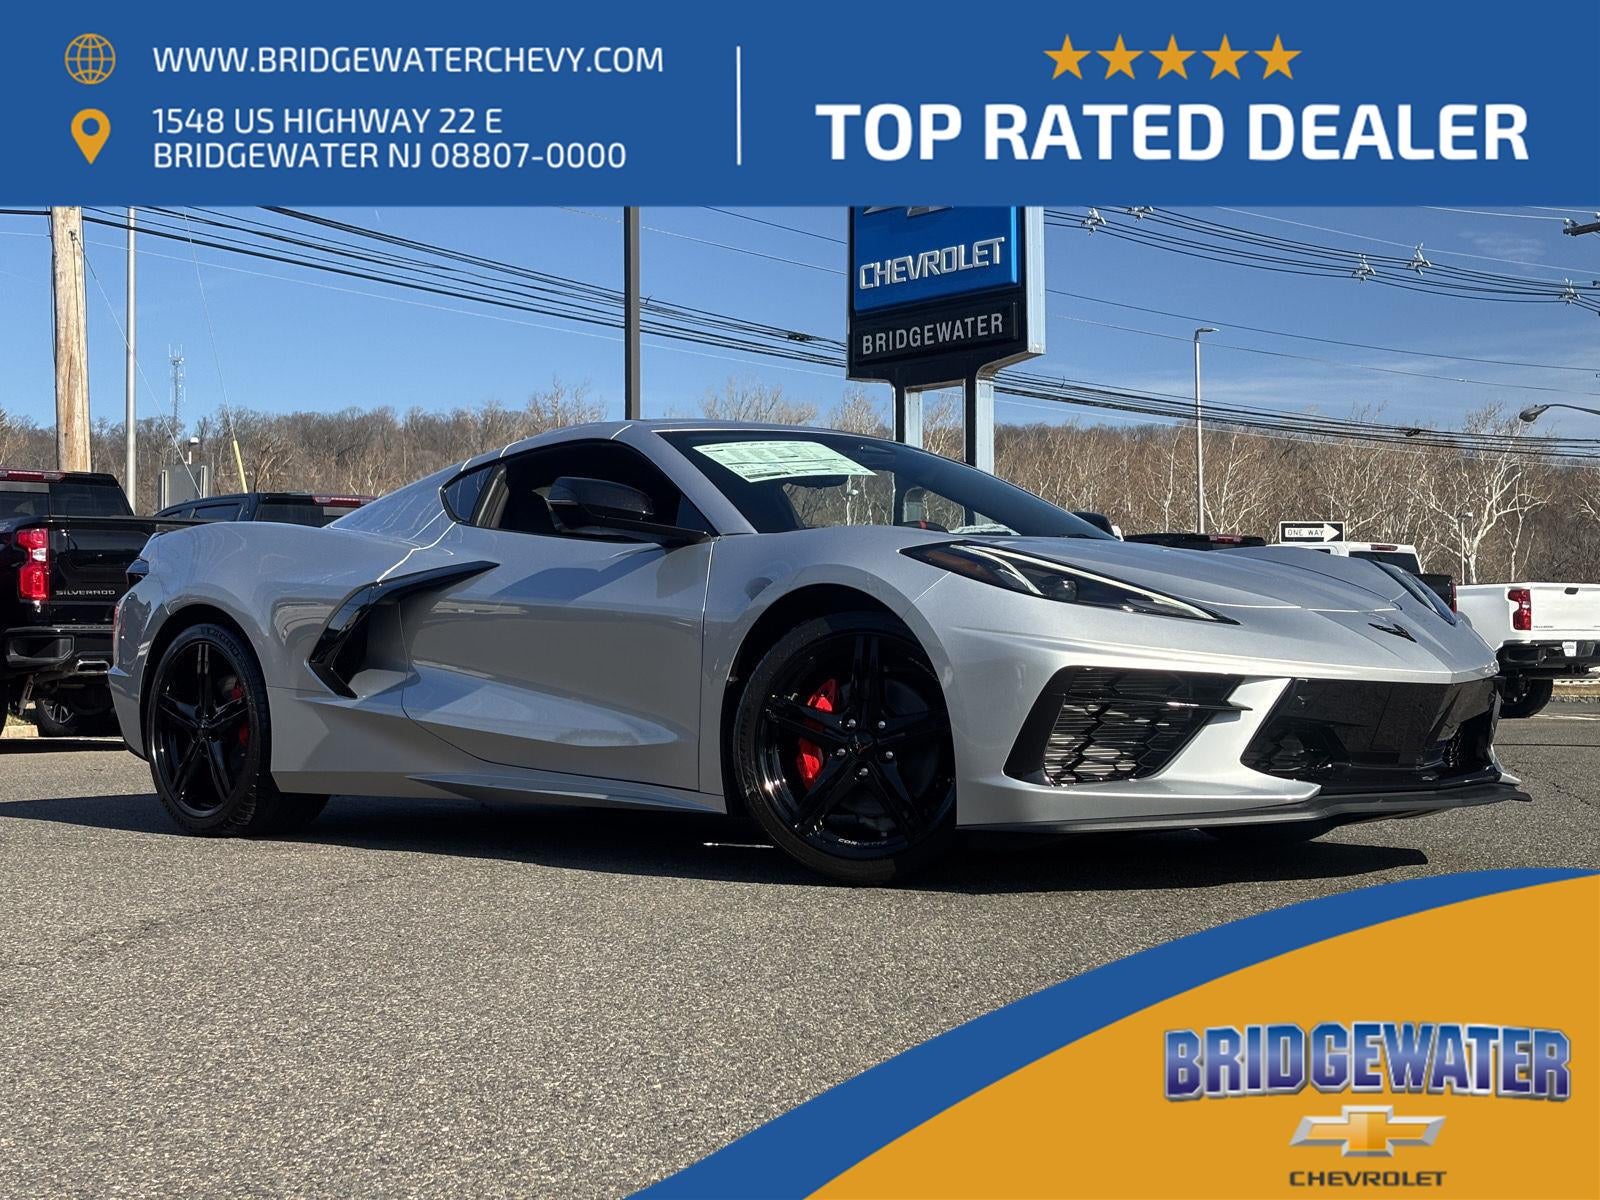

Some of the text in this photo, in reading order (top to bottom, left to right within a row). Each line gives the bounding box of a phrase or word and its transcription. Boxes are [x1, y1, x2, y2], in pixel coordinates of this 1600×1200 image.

[859, 236, 1006, 290] CHEVROLET
[862, 312, 1004, 356] BRIDGEWATER
[1287, 529, 1325, 537] ONE WAY
